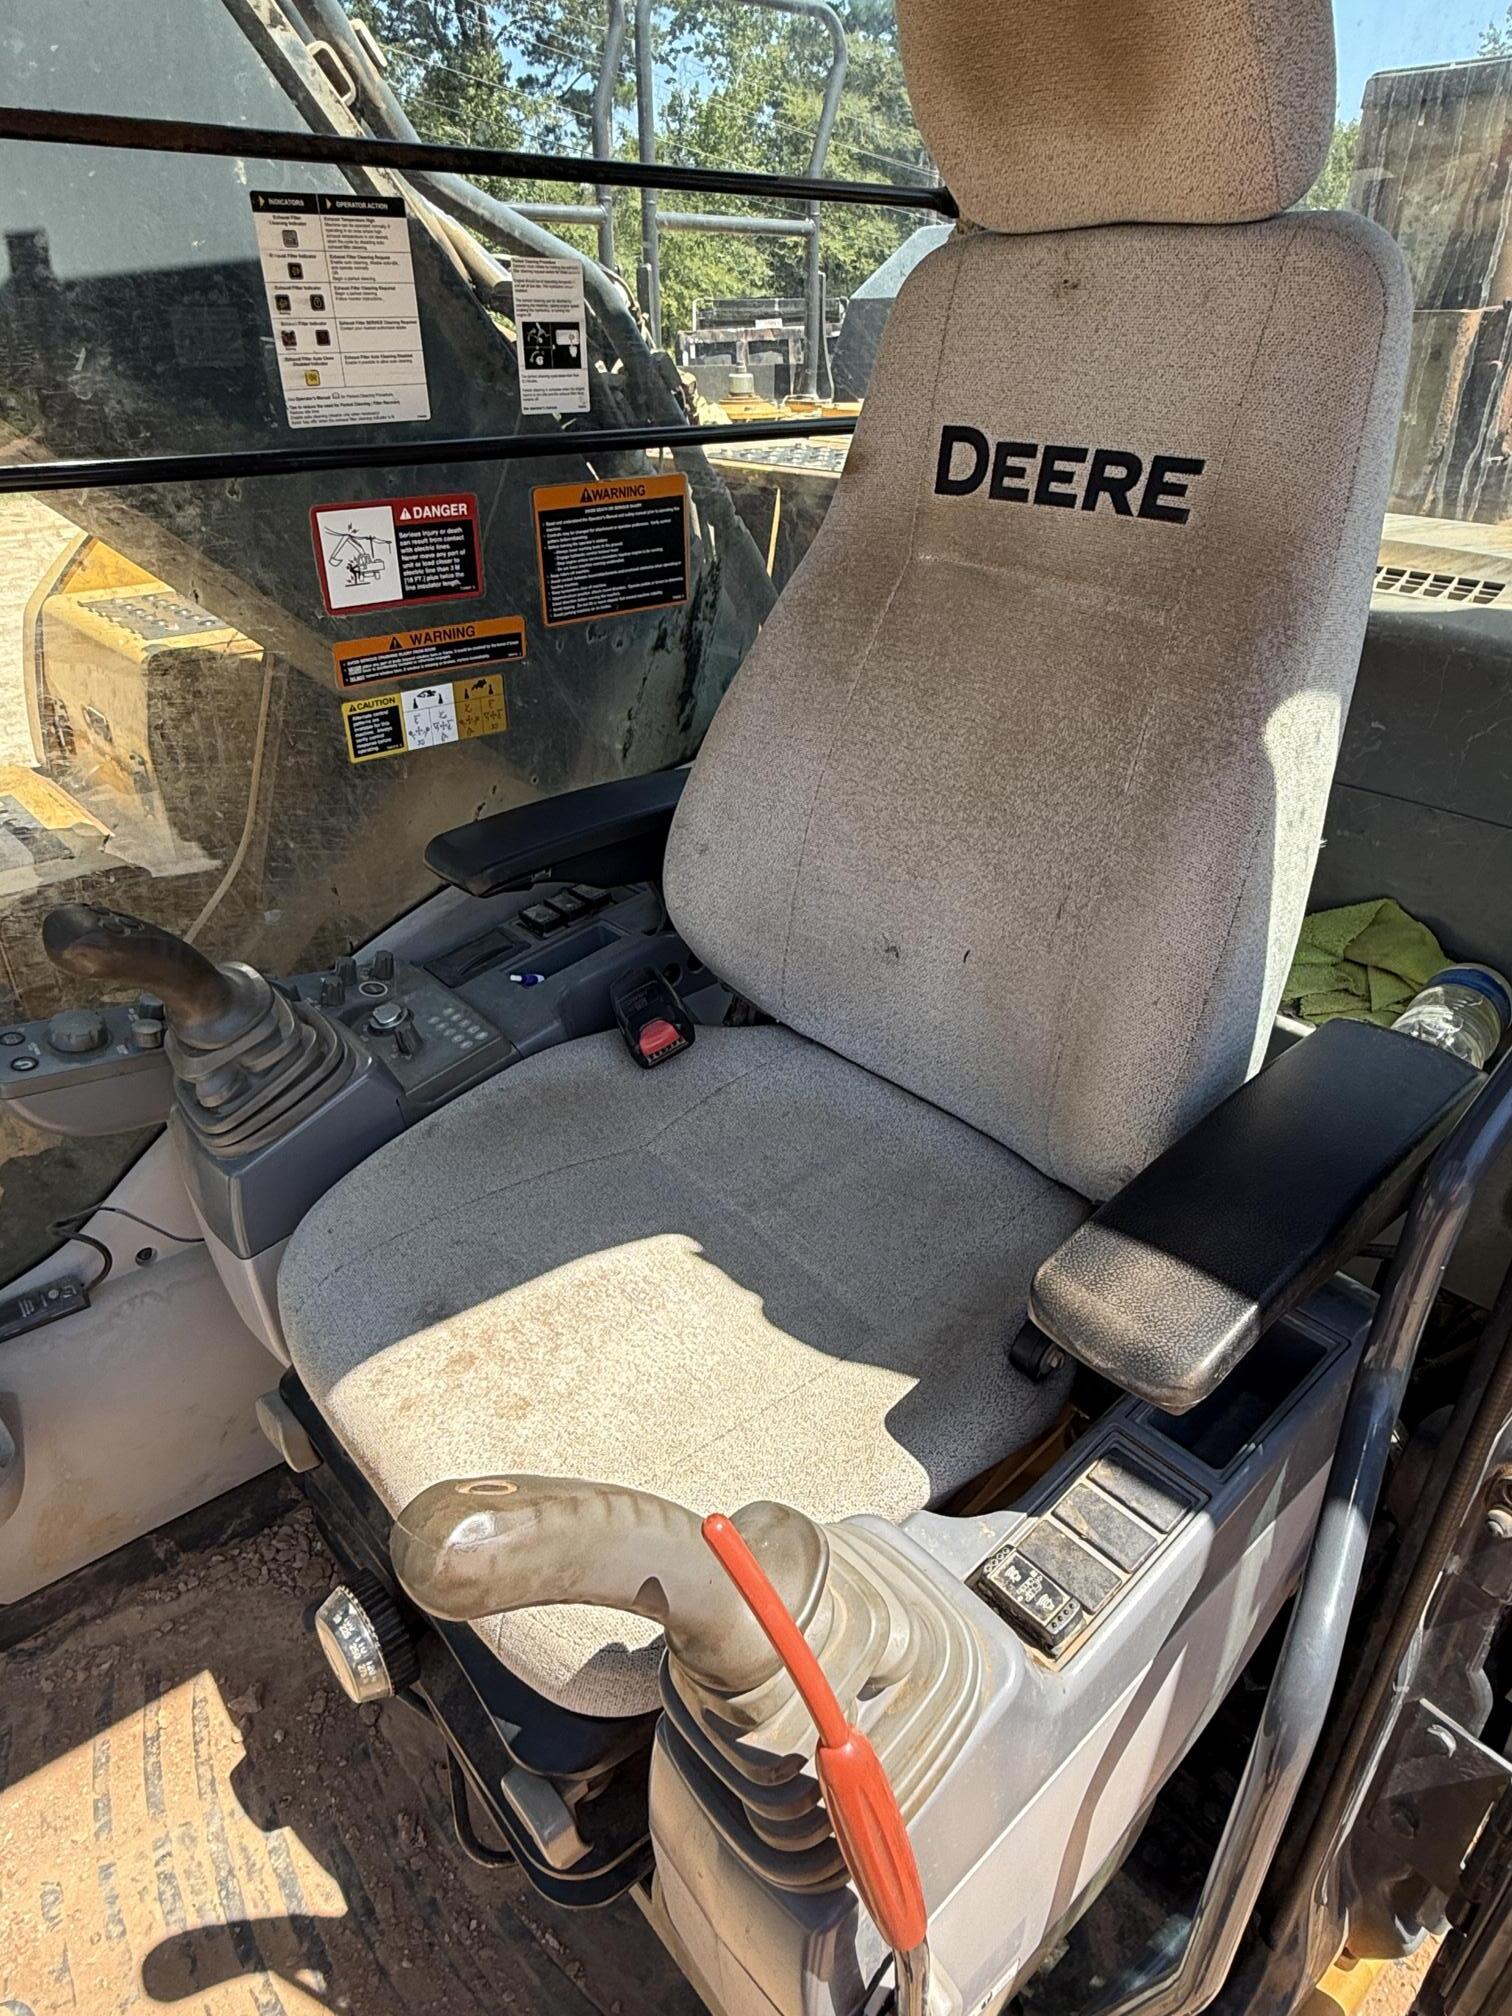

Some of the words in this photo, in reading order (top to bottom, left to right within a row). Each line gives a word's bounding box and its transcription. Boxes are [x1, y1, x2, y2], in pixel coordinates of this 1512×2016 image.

[268, 197, 304, 206] INDICATORS
[935, 425, 1205, 525] DEERE
[591, 484, 645, 501] WARNING
[412, 502, 468, 519] DANGER
[409, 624, 475, 646] WARNING
[356, 696, 396, 710] CAUTION
